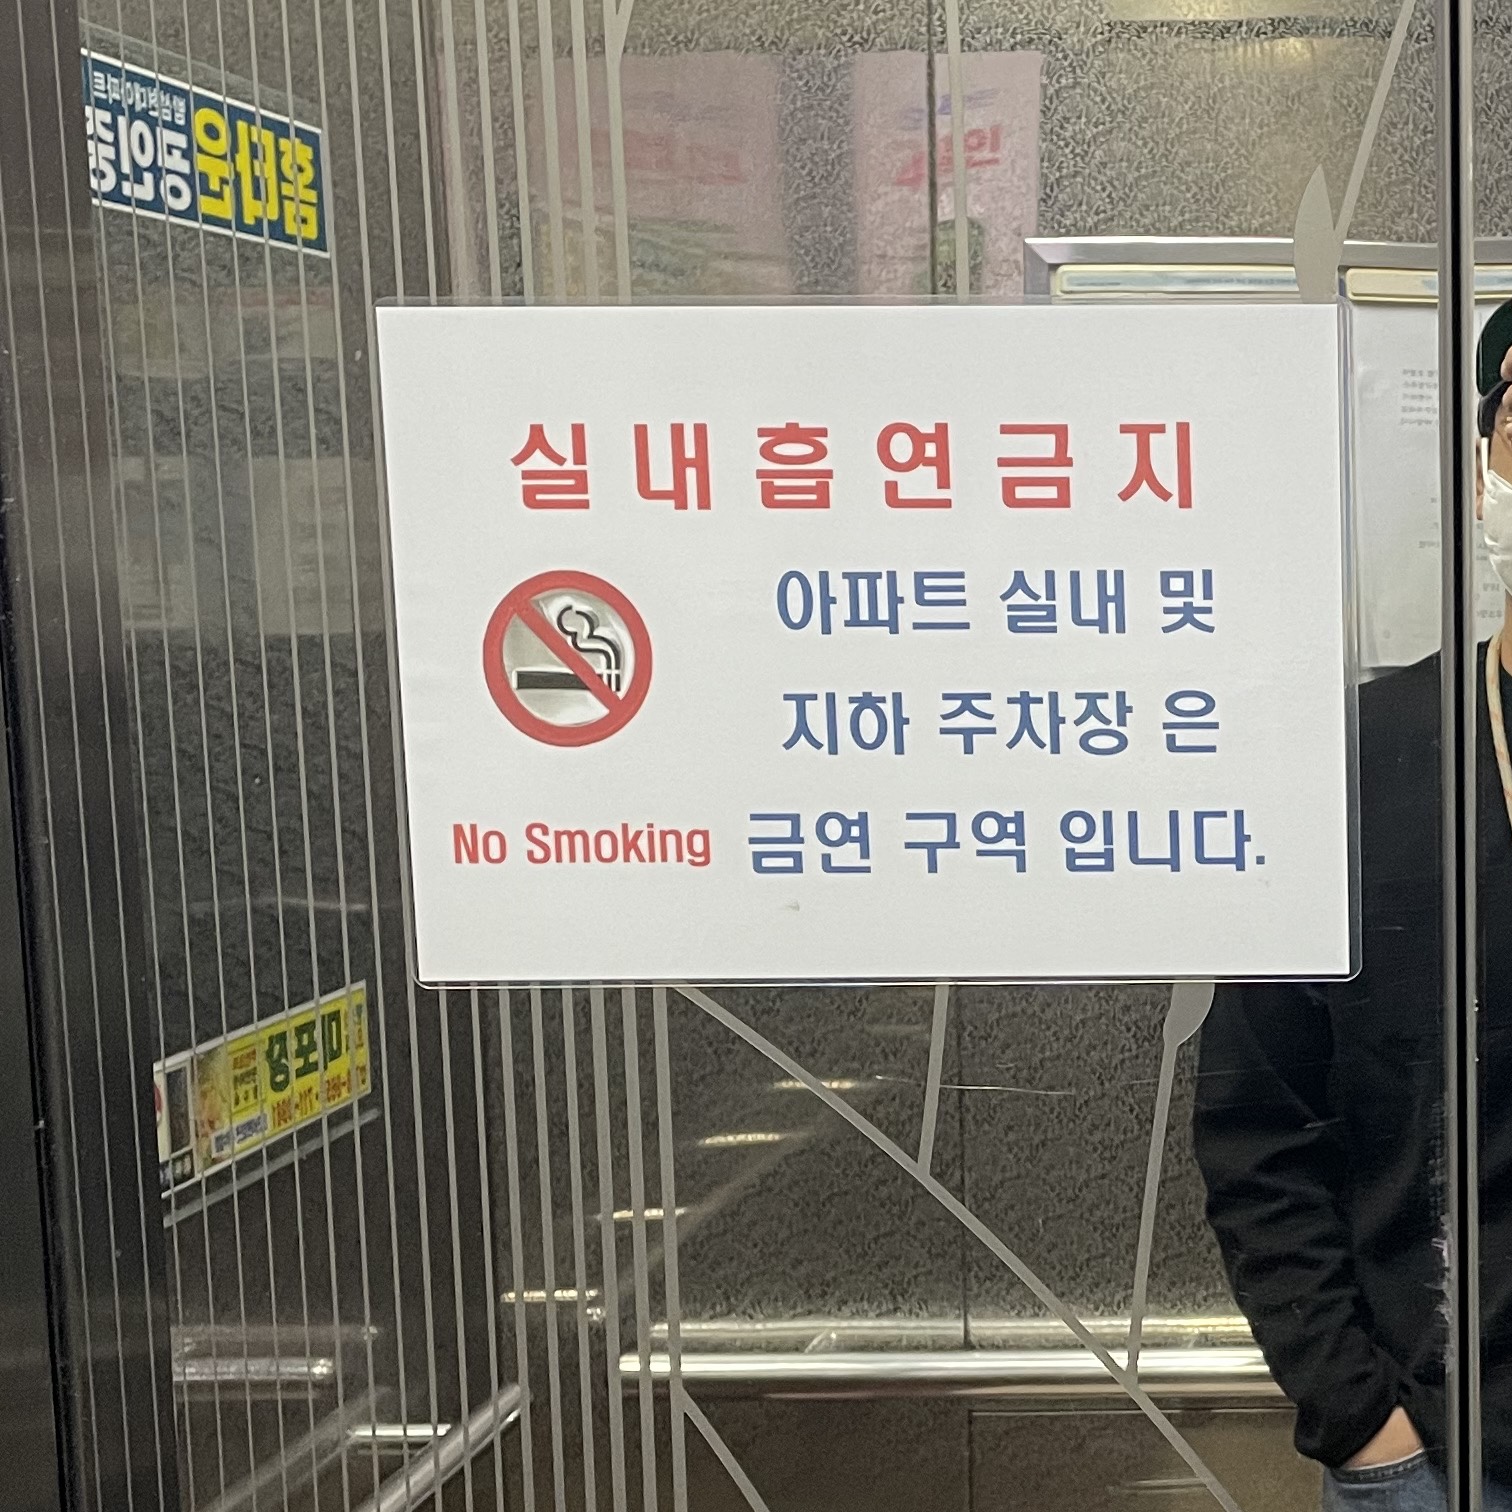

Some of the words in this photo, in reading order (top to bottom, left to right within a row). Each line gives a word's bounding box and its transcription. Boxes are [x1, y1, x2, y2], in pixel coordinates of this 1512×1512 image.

[777, 571, 970, 635] 아파트
[1000, 570, 1125, 634] 실내
[1160, 569, 1215, 633] 및
[782, 692, 910, 755] 지하
[939, 691, 1133, 756] 주차장
[1162, 690, 1219, 753] 은
[453, 824, 506, 864] No
[526, 823, 710, 867] Smoking
[748, 812, 871, 874] 금연
[904, 811, 1026, 873] 구역
[1060, 810, 1265, 872] 입니다.
